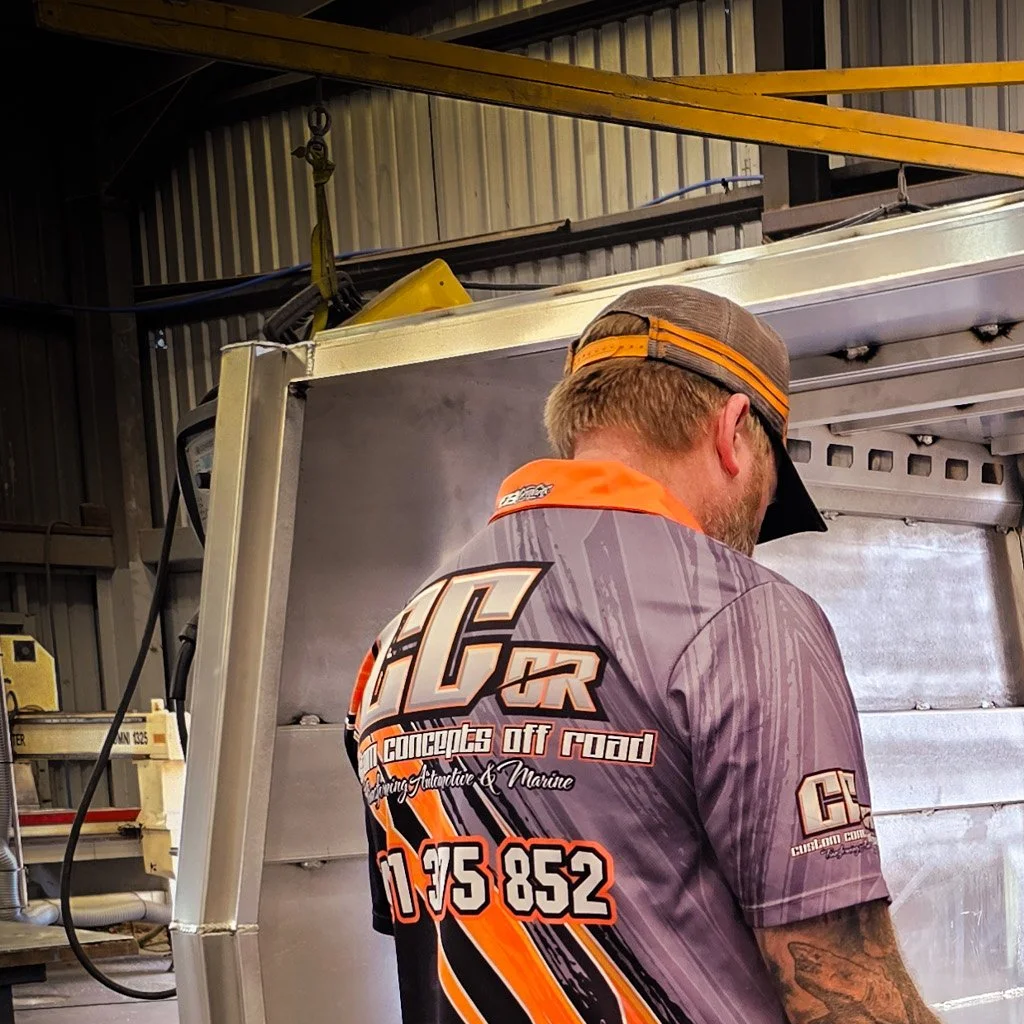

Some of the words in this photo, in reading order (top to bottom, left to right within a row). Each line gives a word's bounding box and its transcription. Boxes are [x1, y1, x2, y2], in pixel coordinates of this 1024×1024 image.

[383, 723, 493, 761] concepts
[502, 723, 552, 755] off
[561, 730, 655, 764] road
[409, 763, 475, 797] Automotive
[479, 760, 501, 796] &
[498, 759, 575, 791] Marine
[502, 845, 609, 916] 852
